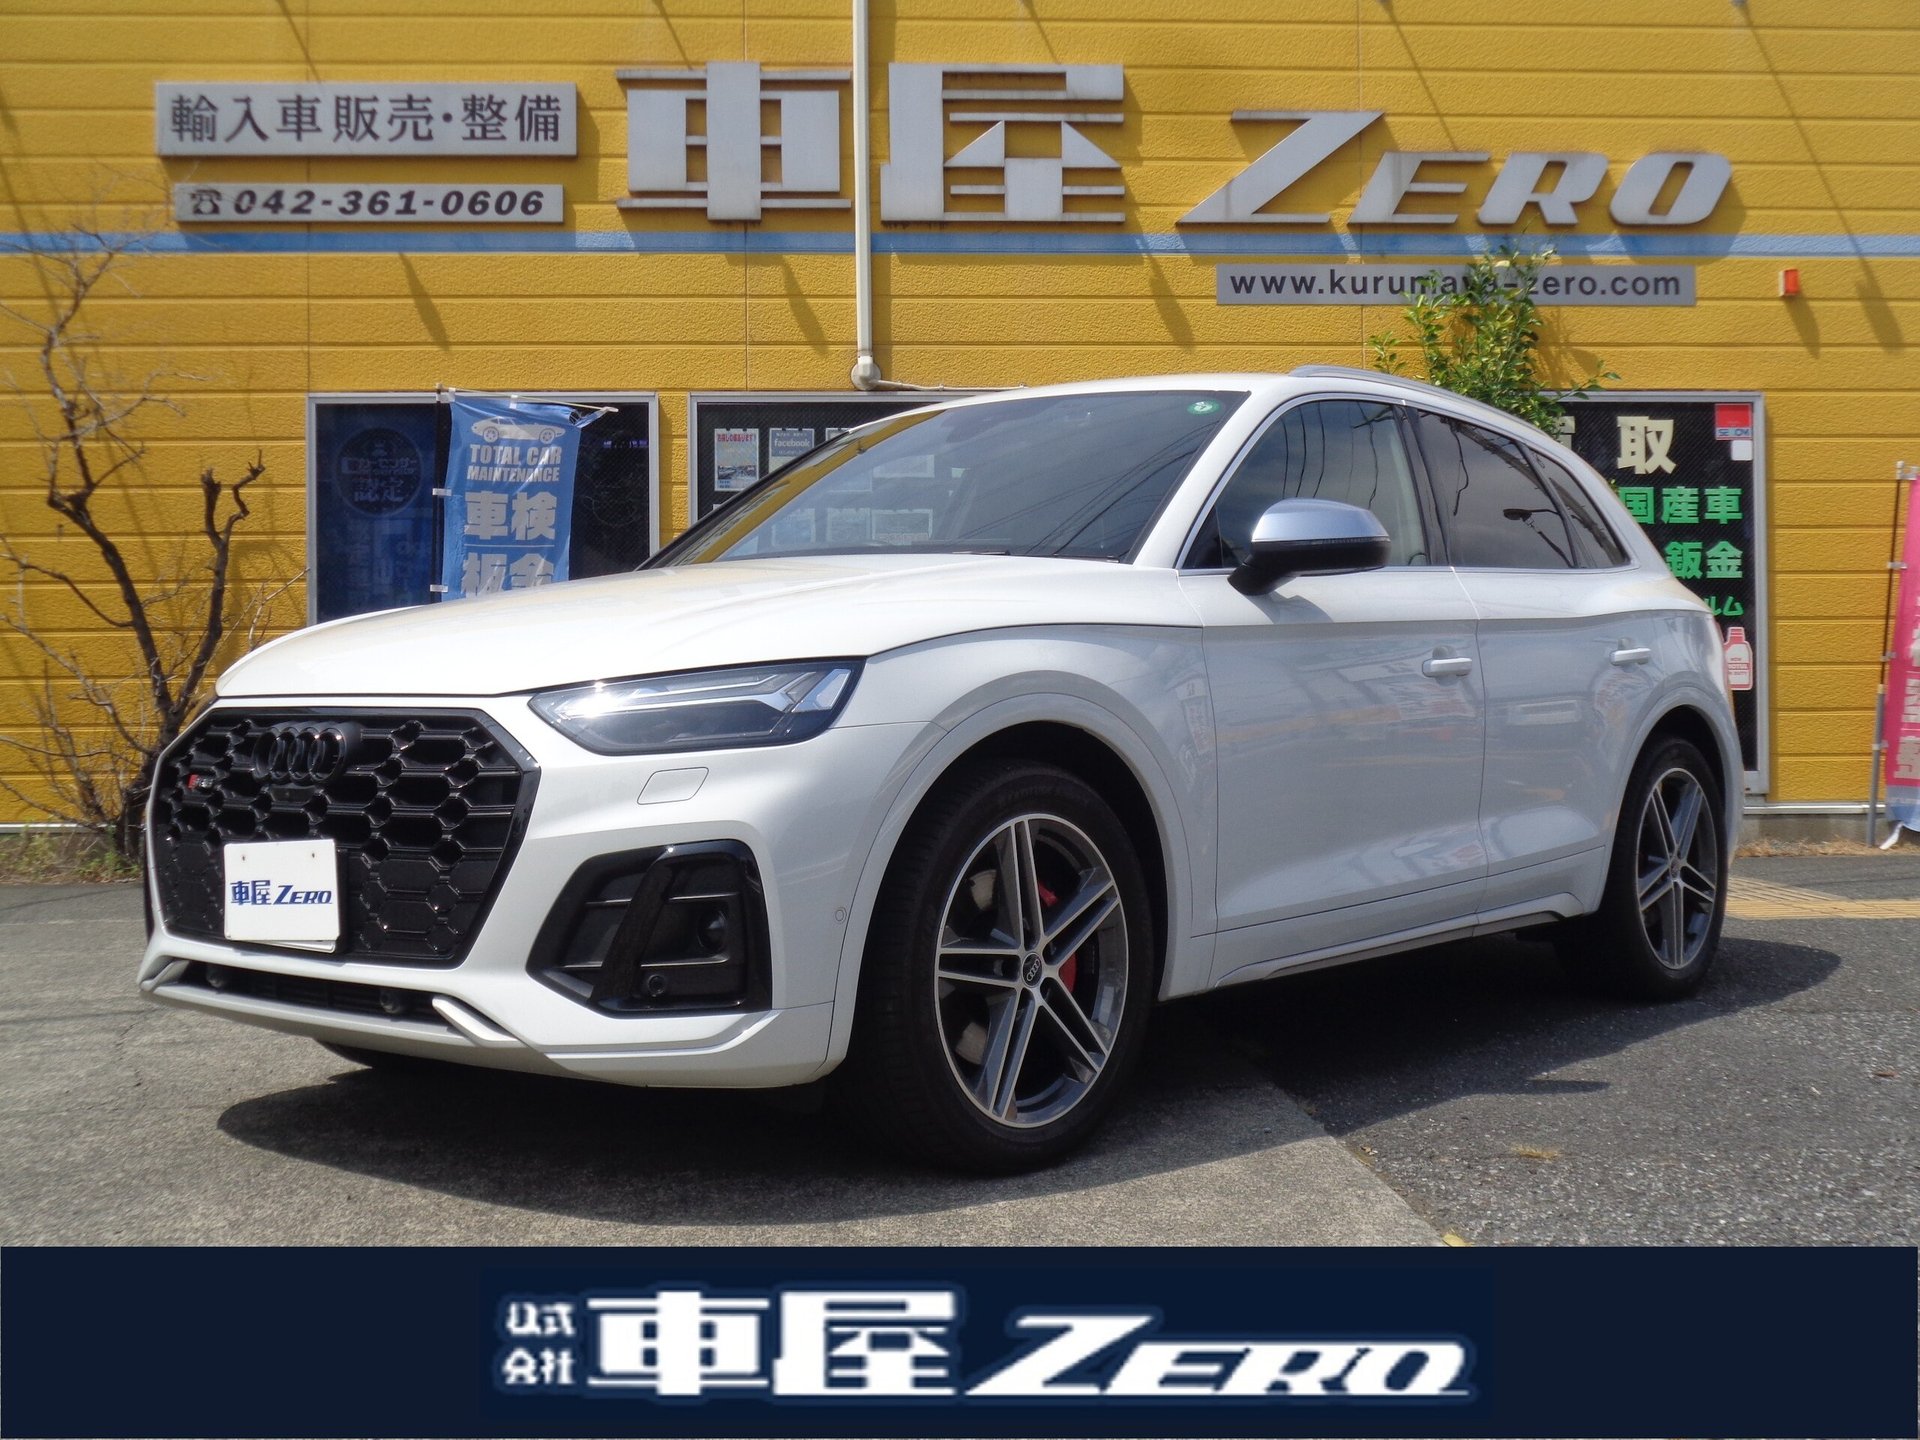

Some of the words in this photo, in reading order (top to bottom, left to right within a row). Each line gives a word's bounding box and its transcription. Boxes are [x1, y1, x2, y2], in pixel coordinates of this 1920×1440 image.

[171, 93, 563, 142] 輸入車販売・整備
[616, 61, 1125, 222] 車屋
[1176, 110, 1732, 226] ZERO
[234, 189, 544, 216] 042-361-0606
[1230, 269, 1681, 296] www.kurumaa-zero.com
[470, 444, 521, 465] TOTAL
[527, 447, 562, 465] CAR
[774, 438, 811, 448] facebook
[467, 466, 560, 482] MAINTENANCE
[464, 490, 557, 541] 車検
[1618, 486, 1743, 525] 国産車
[1664, 541, 1744, 580] 鈑金
[230, 879, 272, 905] 車屋
[273, 884, 333, 905] ZERO
